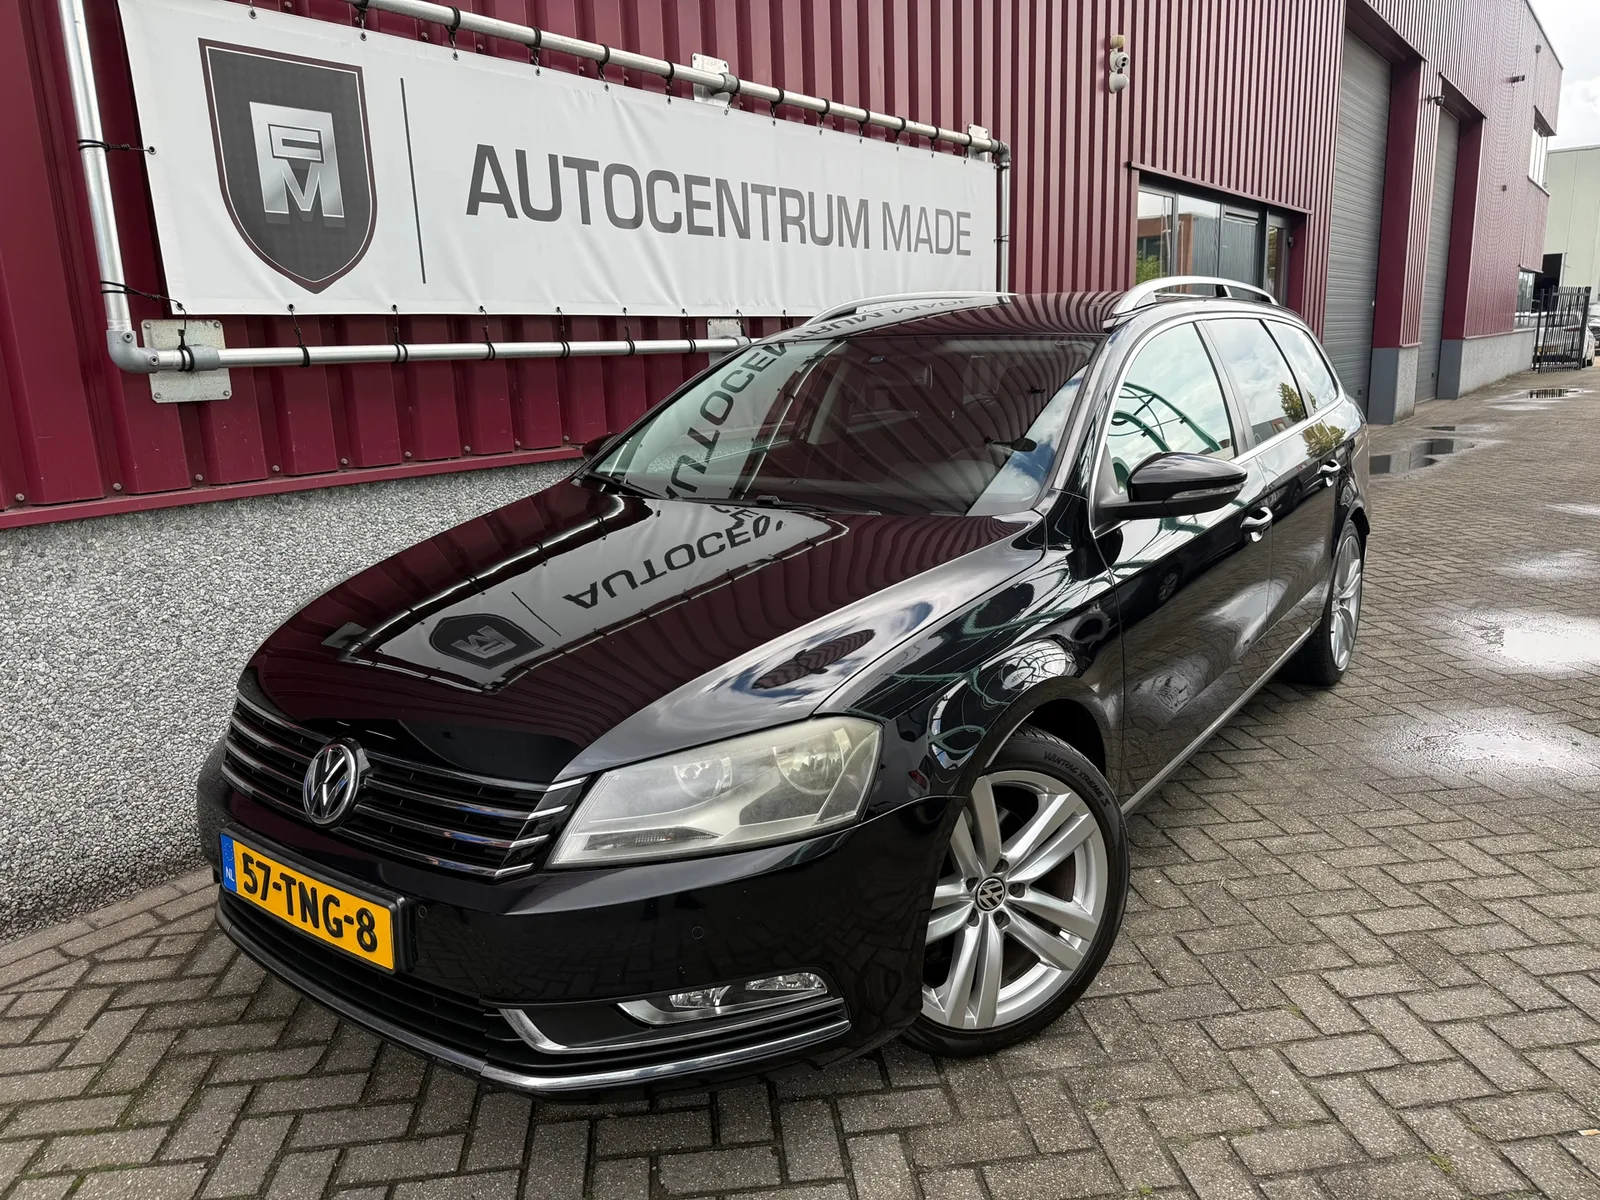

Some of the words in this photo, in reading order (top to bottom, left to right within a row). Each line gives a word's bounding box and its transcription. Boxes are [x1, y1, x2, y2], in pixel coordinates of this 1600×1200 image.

[466, 144, 870, 250] AUTOCENTRUM
[882, 201, 972, 257] MADE
[225, 866, 235, 883] NL
[241, 852, 378, 953] 57-TNG-8
